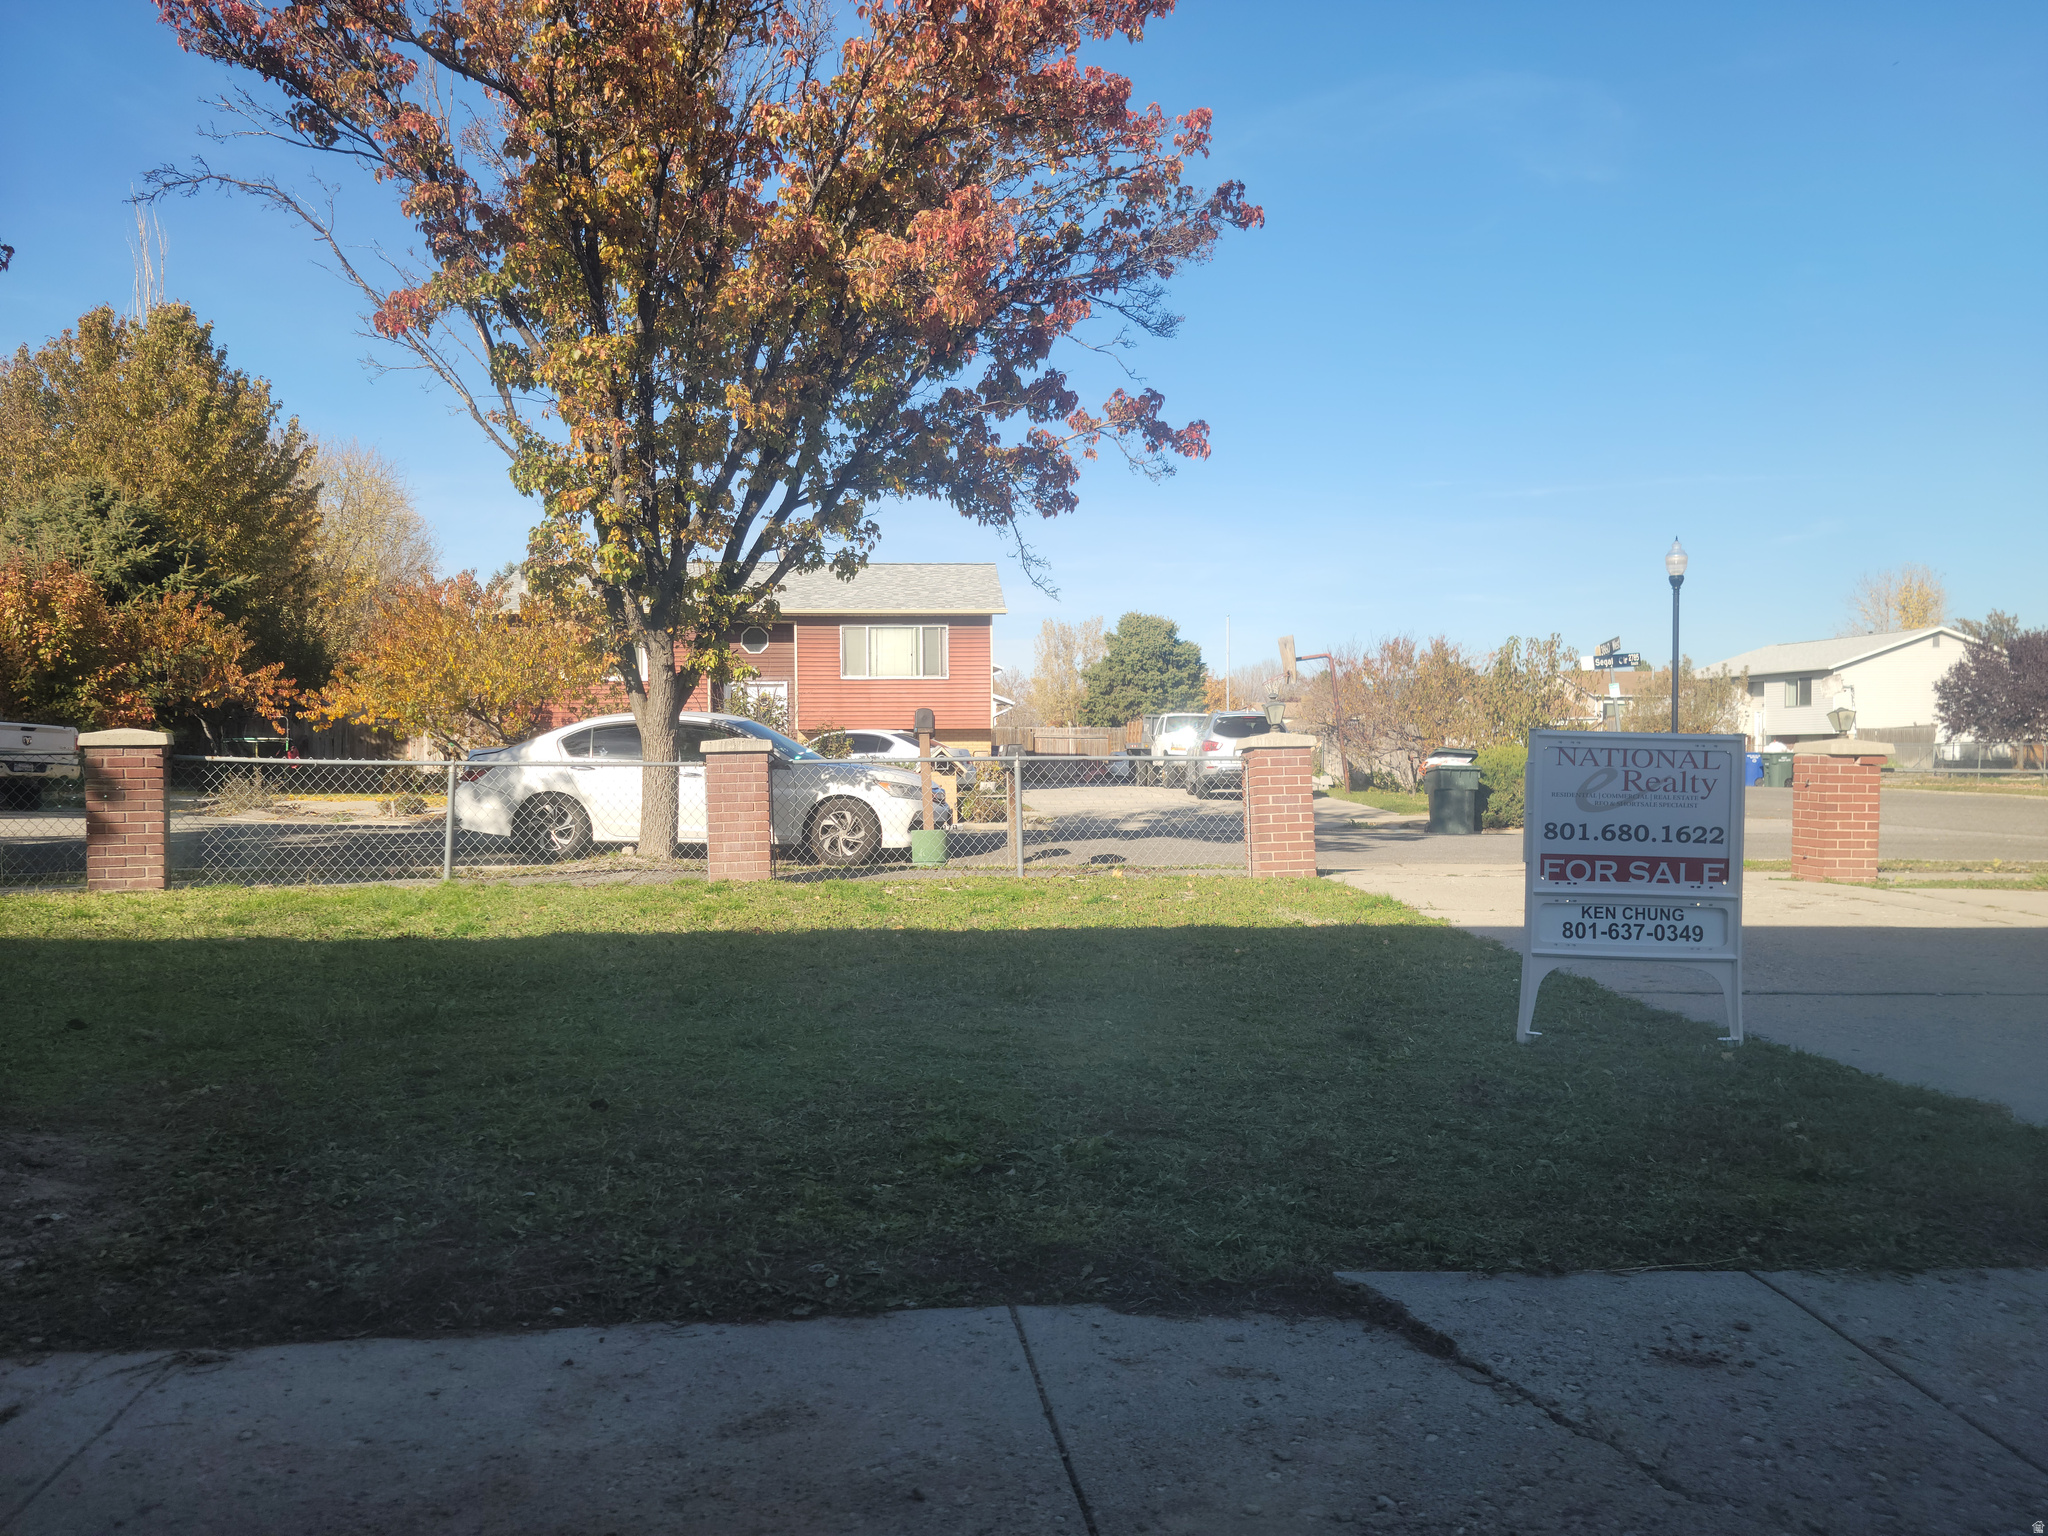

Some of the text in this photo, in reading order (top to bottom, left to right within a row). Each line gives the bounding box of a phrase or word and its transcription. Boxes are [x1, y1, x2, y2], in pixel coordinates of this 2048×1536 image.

[1557, 747, 1721, 770] NATIONAL
[1622, 769, 1719, 800] Realty
[1551, 791, 1598, 799] RESIDENTIAL
[1602, 792, 1650, 801] COMMERCIAL
[1673, 794, 1699, 802] ESTATE
[1616, 801, 1658, 809] SHORTSALE
[1543, 822, 1725, 845] 801.680.1622
[1543, 858, 1725, 885] FOR SALE
[1581, 905, 1685, 921] KEN CHUNG
[1562, 921, 1704, 942] 801-637-0349
